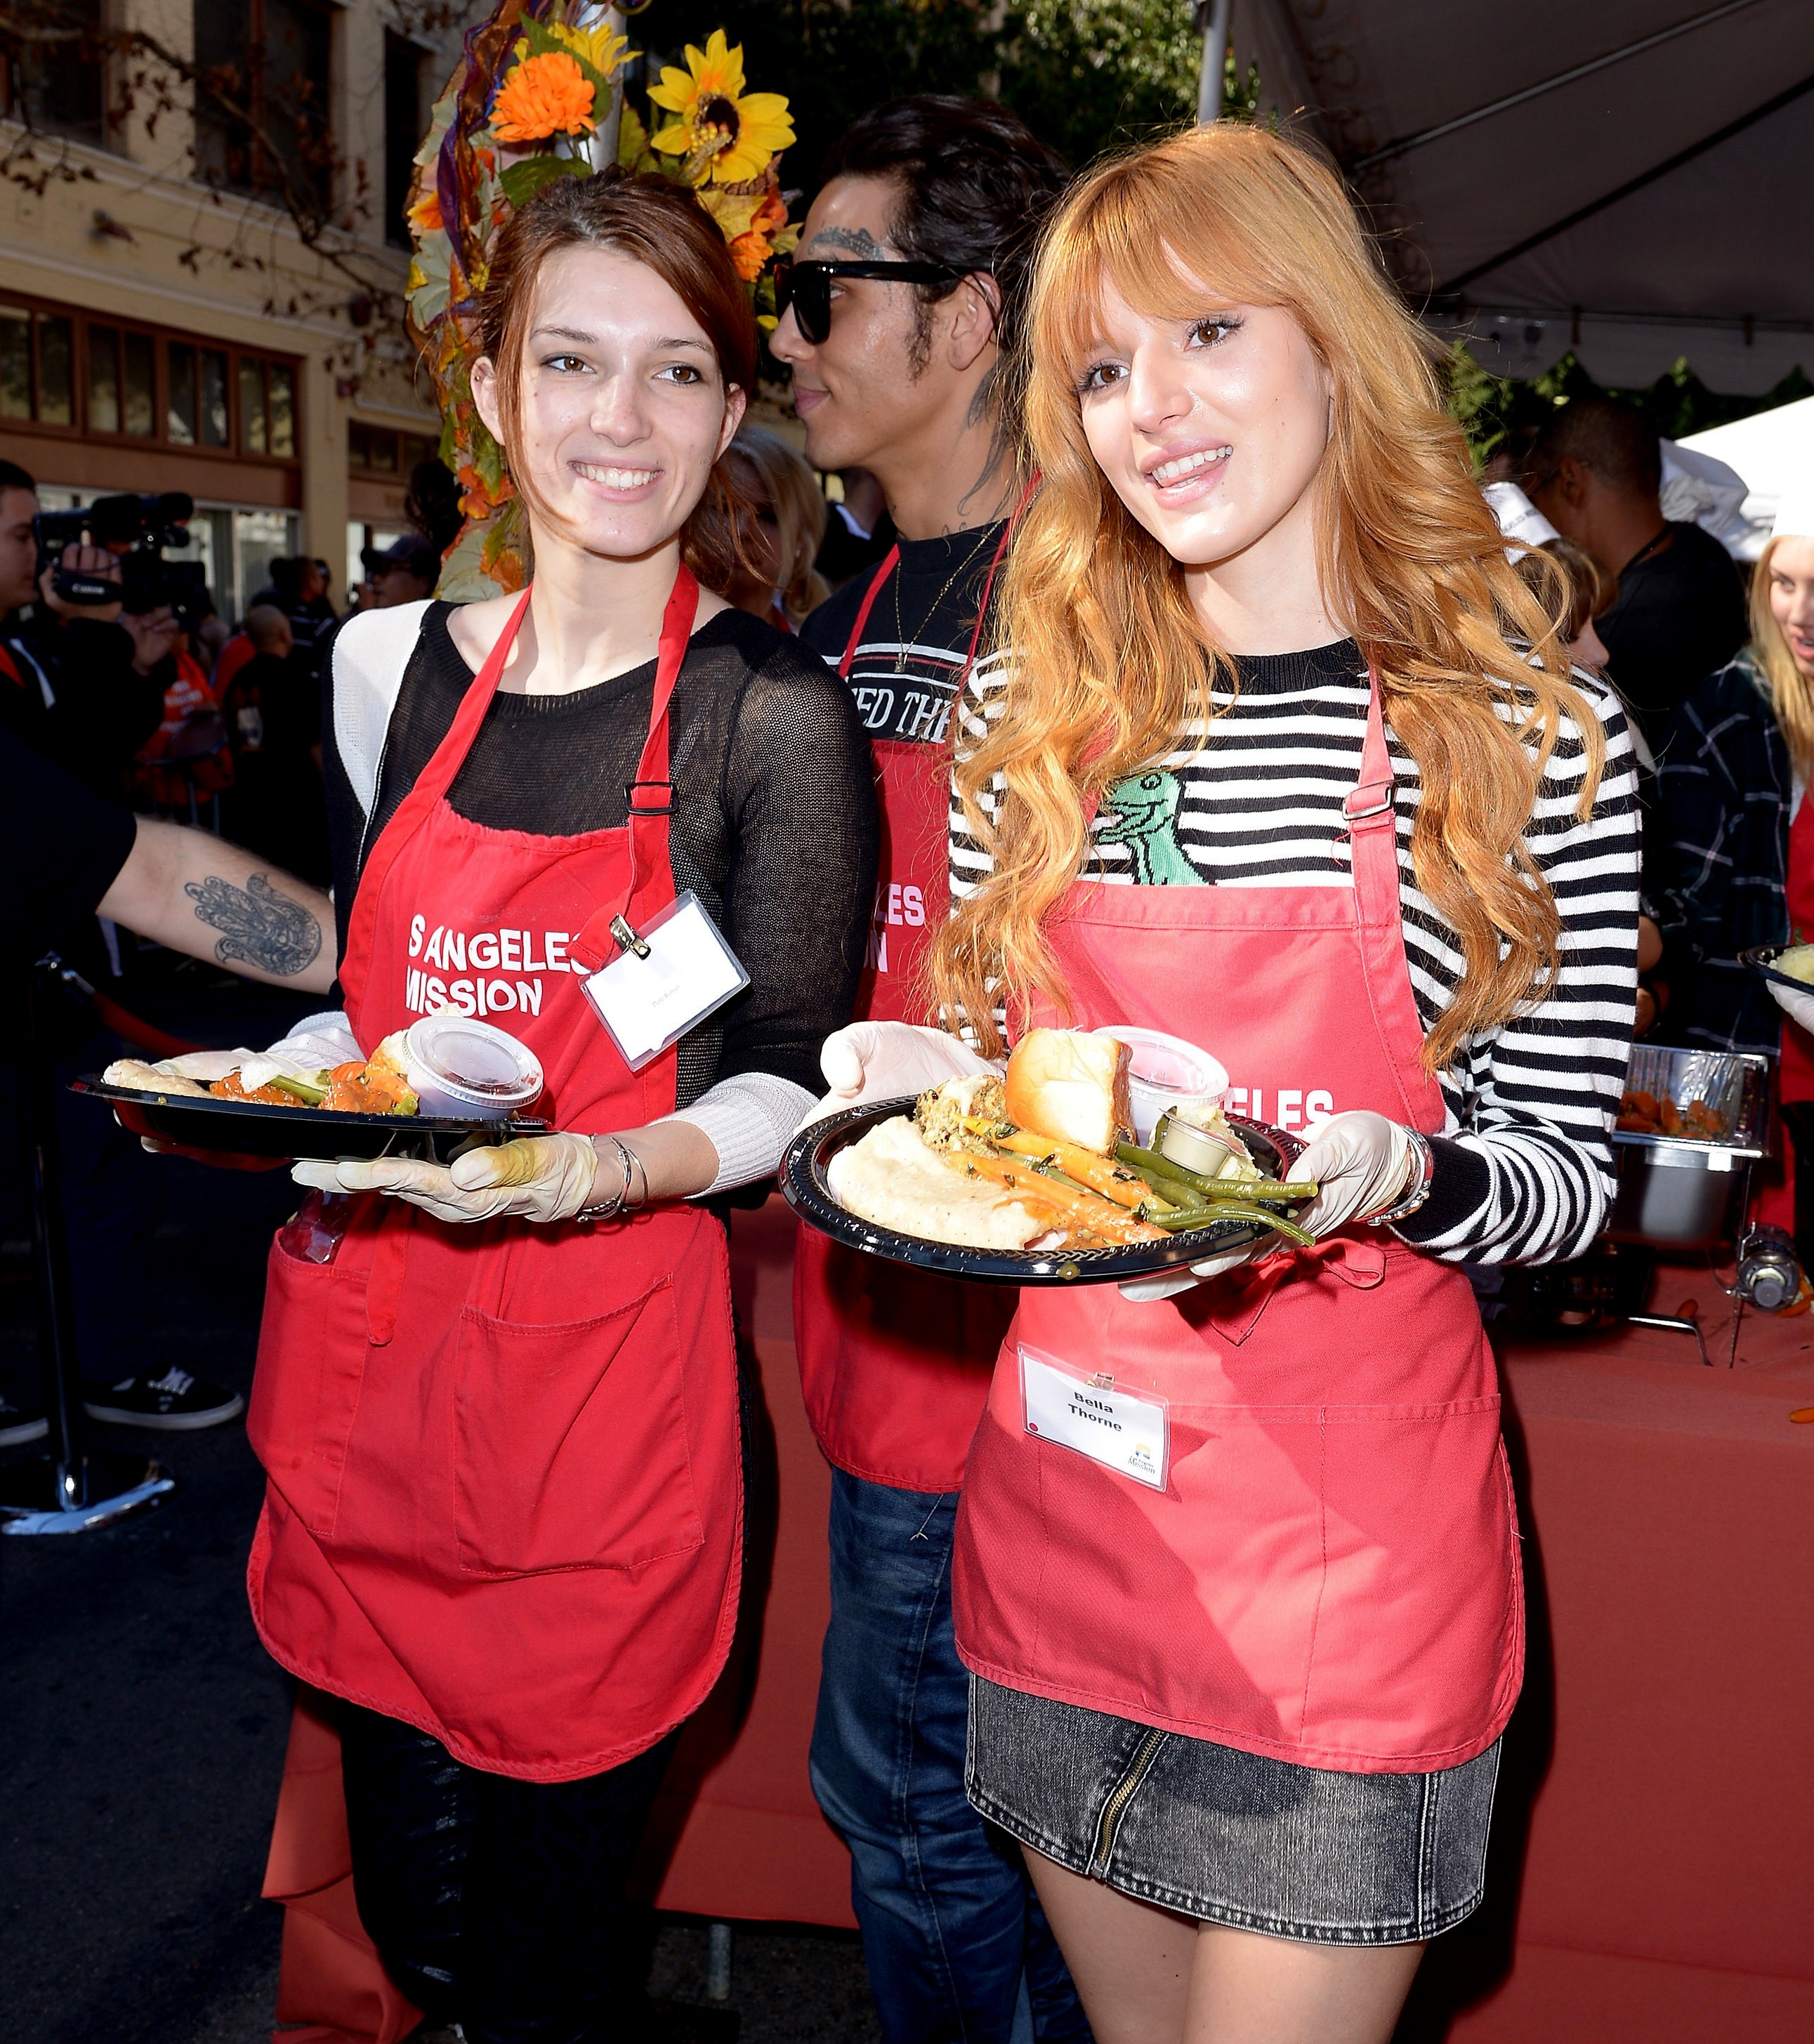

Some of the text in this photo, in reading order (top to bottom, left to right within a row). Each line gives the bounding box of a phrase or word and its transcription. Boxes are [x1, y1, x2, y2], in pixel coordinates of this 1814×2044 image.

[850, 687, 895, 728] ED
[1074, 1392, 1113, 1413] Bella
[1068, 1404, 1122, 1432] Thorne
